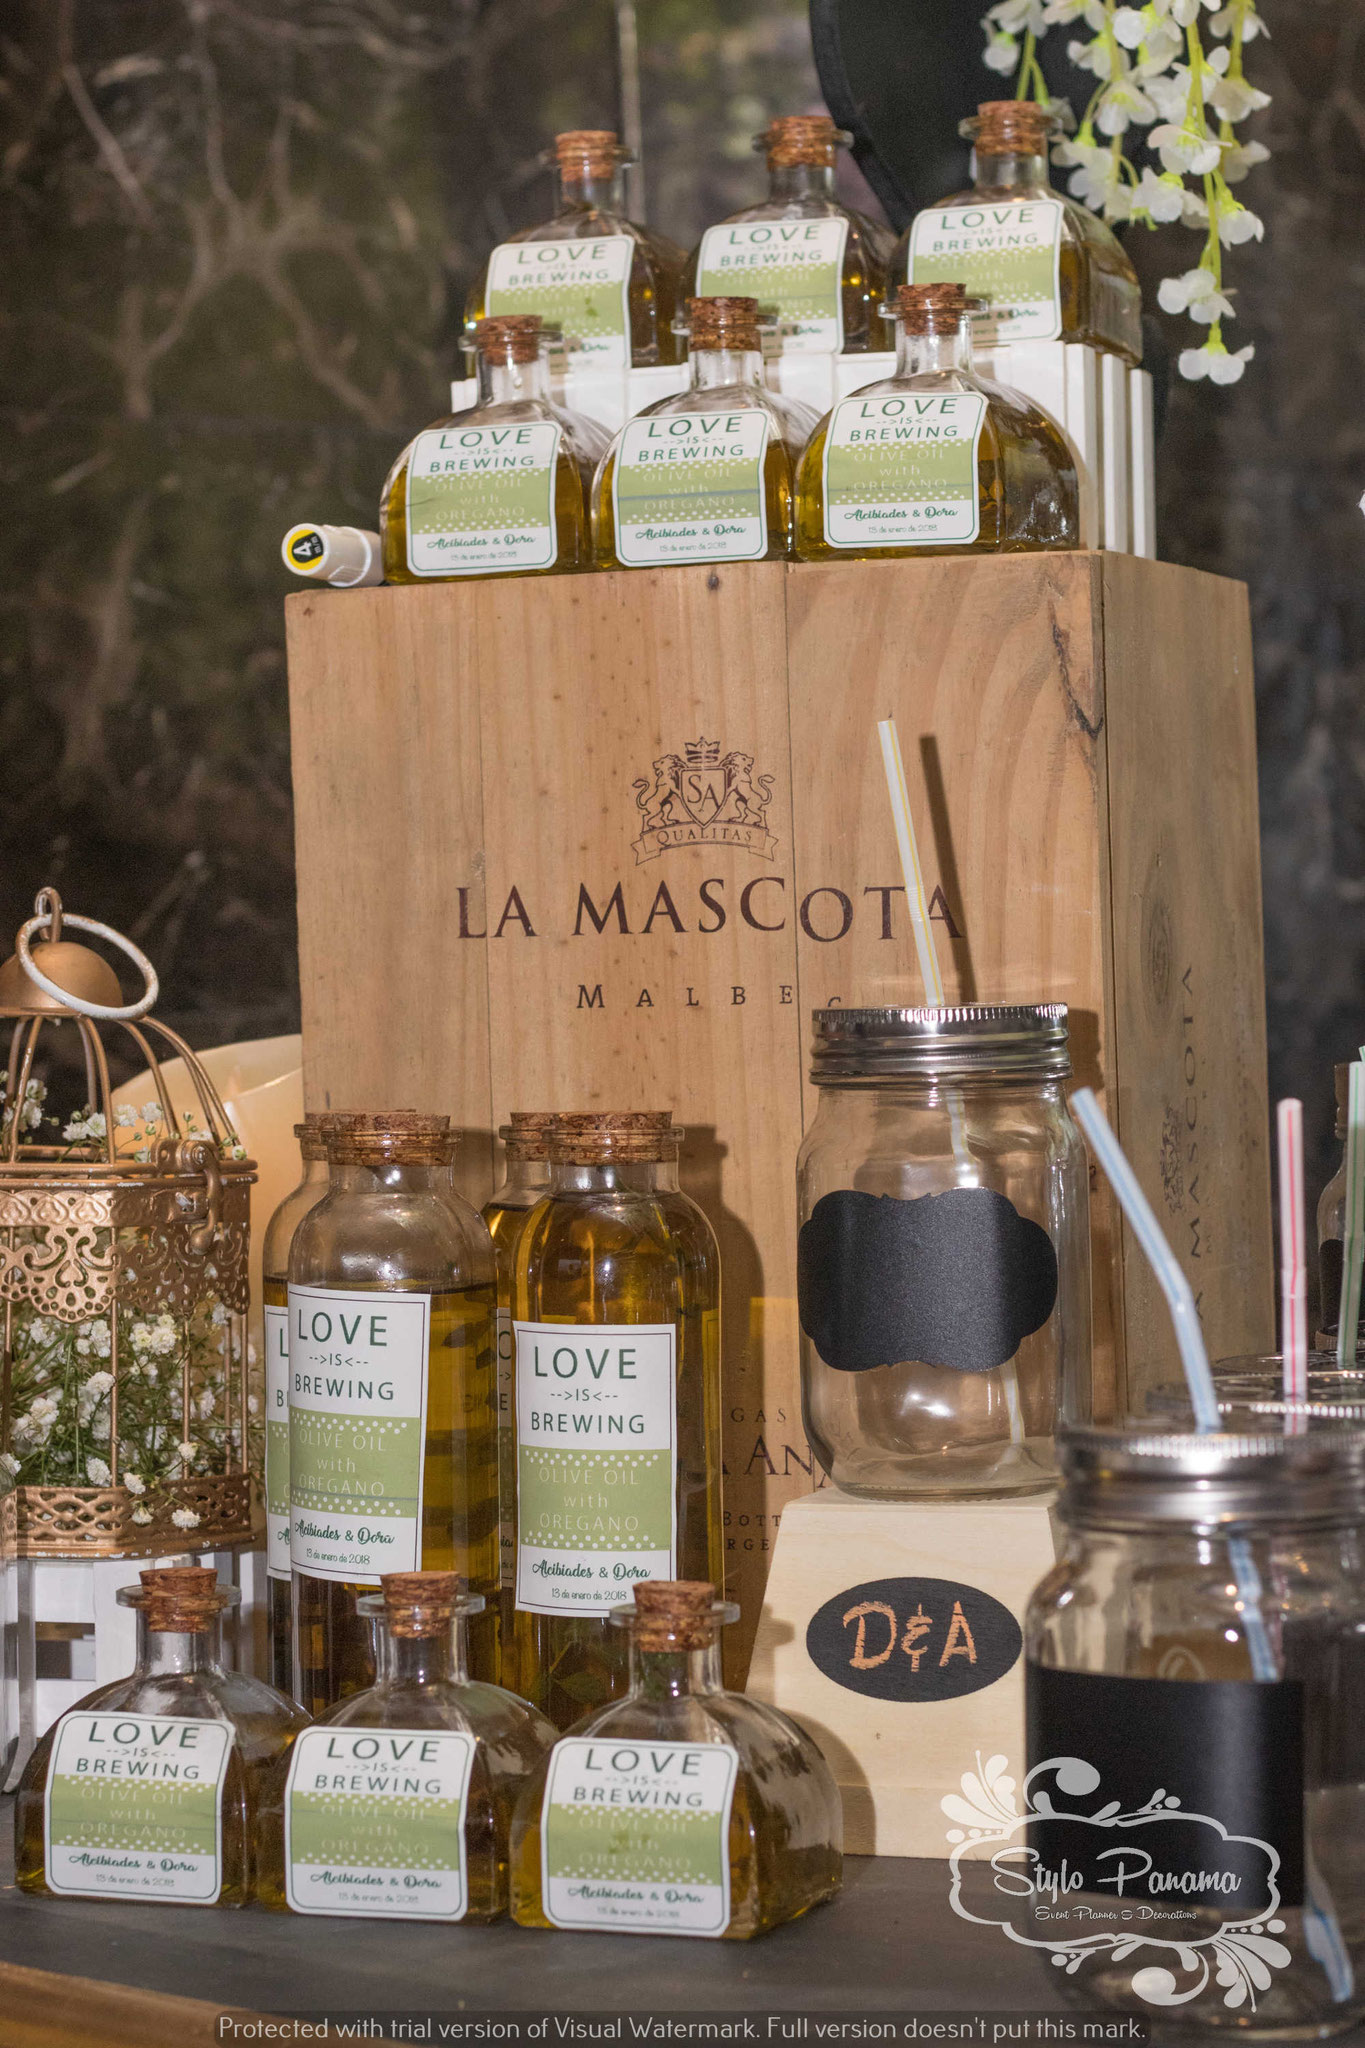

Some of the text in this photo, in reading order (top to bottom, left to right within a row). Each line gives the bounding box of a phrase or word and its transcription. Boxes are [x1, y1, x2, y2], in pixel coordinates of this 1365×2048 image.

[942, 208, 1034, 229] LOVE
[729, 225, 820, 244] LOVE
[933, 233, 1038, 251] BREWING
[518, 244, 606, 264] LOVE
[721, 250, 822, 266] BREWING
[509, 269, 608, 285] BREWING
[861, 398, 957, 418] LOVE
[648, 417, 742, 438] LOVE
[850, 426, 958, 441] BREWING
[440, 428, 532, 449] LOVE
[638, 445, 743, 461] BREWING
[854, 449, 944, 462] OLIVE OIL
[430, 456, 534, 472] BREWING
[880, 465, 921, 476] with
[643, 468, 733, 481] OLIVE OIL
[435, 478, 524, 492] OLIVE OIL
[668, 484, 709, 495] with
[854, 479, 947, 490] OREGANO
[461, 494, 499, 505] with
[645, 496, 734, 510] OREGANO
[436, 507, 525, 520] OREGANO
[844, 509, 907, 521] Alcibiades
[925, 507, 957, 518] Dora
[636, 528, 697, 540] Alcibiades
[714, 524, 746, 535] Dora
[427, 534, 536, 549] Alcibiades & Dora
[687, 774, 721, 812] SA
[657, 828, 751, 846] QUALITAS
[457, 876, 964, 943] LA MASCOTA
[298, 1309, 388, 1347] LOVE
[534, 1346, 637, 1379] LOVE
[295, 1374, 394, 1400] BREWING
[532, 1412, 645, 1434] BREWING
[299, 1429, 385, 1450] OLIVE OIL
[318, 1457, 356, 1472] with
[539, 1467, 639, 1485] OLIVE OIL
[299, 1475, 384, 1497] OREGANO
[564, 1494, 608, 1508] with
[539, 1513, 639, 1531] OREGANO
[295, 1520, 341, 1540] Alcibiades
[346, 1530, 354, 1541] &
[358, 1528, 394, 1544] Dora
[306, 1548, 370, 1564] 13 de enero de 2018
[532, 1560, 594, 1578] Alcibiades
[600, 1567, 608, 1578] &
[613, 1564, 651, 1580] Dora
[552, 1589, 627, 1600] 13 de enero de 2018
[89, 1722, 199, 1748] LOVE
[327, 1738, 440, 1762] LOVE
[77, 1758, 199, 1779] BREWING
[585, 1749, 702, 1776] LOVE
[315, 1775, 441, 1794] BREWING
[81, 1787, 182, 1805] OLIVE OIL
[574, 1787, 703, 1806] BREWING
[110, 1808, 156, 1820] with
[81, 1823, 186, 1839] OREGANO
[69, 1853, 140, 1868] Alcibiades
[161, 1860, 198, 1872] Dora
[311, 1871, 383, 1885] Alcibiades
[404, 1875, 442, 1888] Dora
